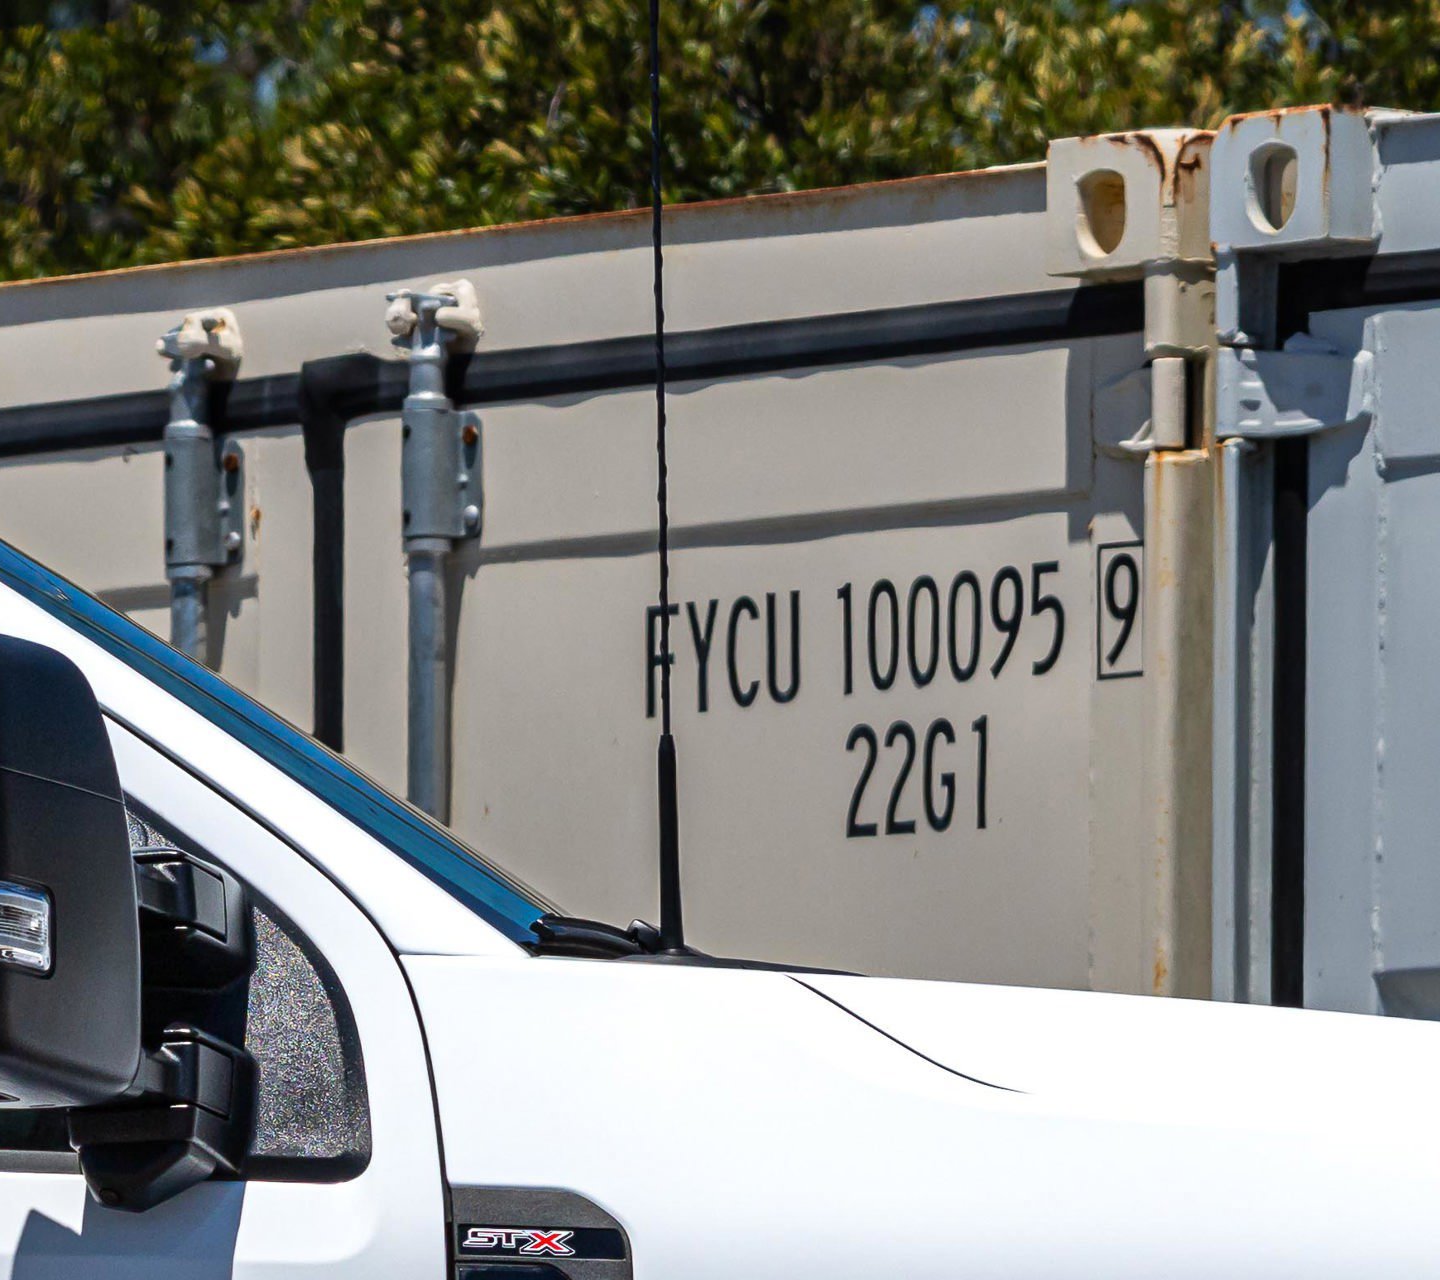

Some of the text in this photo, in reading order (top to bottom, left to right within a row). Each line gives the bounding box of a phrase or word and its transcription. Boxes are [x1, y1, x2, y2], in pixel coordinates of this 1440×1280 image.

[646, 552, 1140, 719] FYCU 100095 9
[845, 714, 988, 838] 22G1
[462, 1227, 575, 1256] STX
